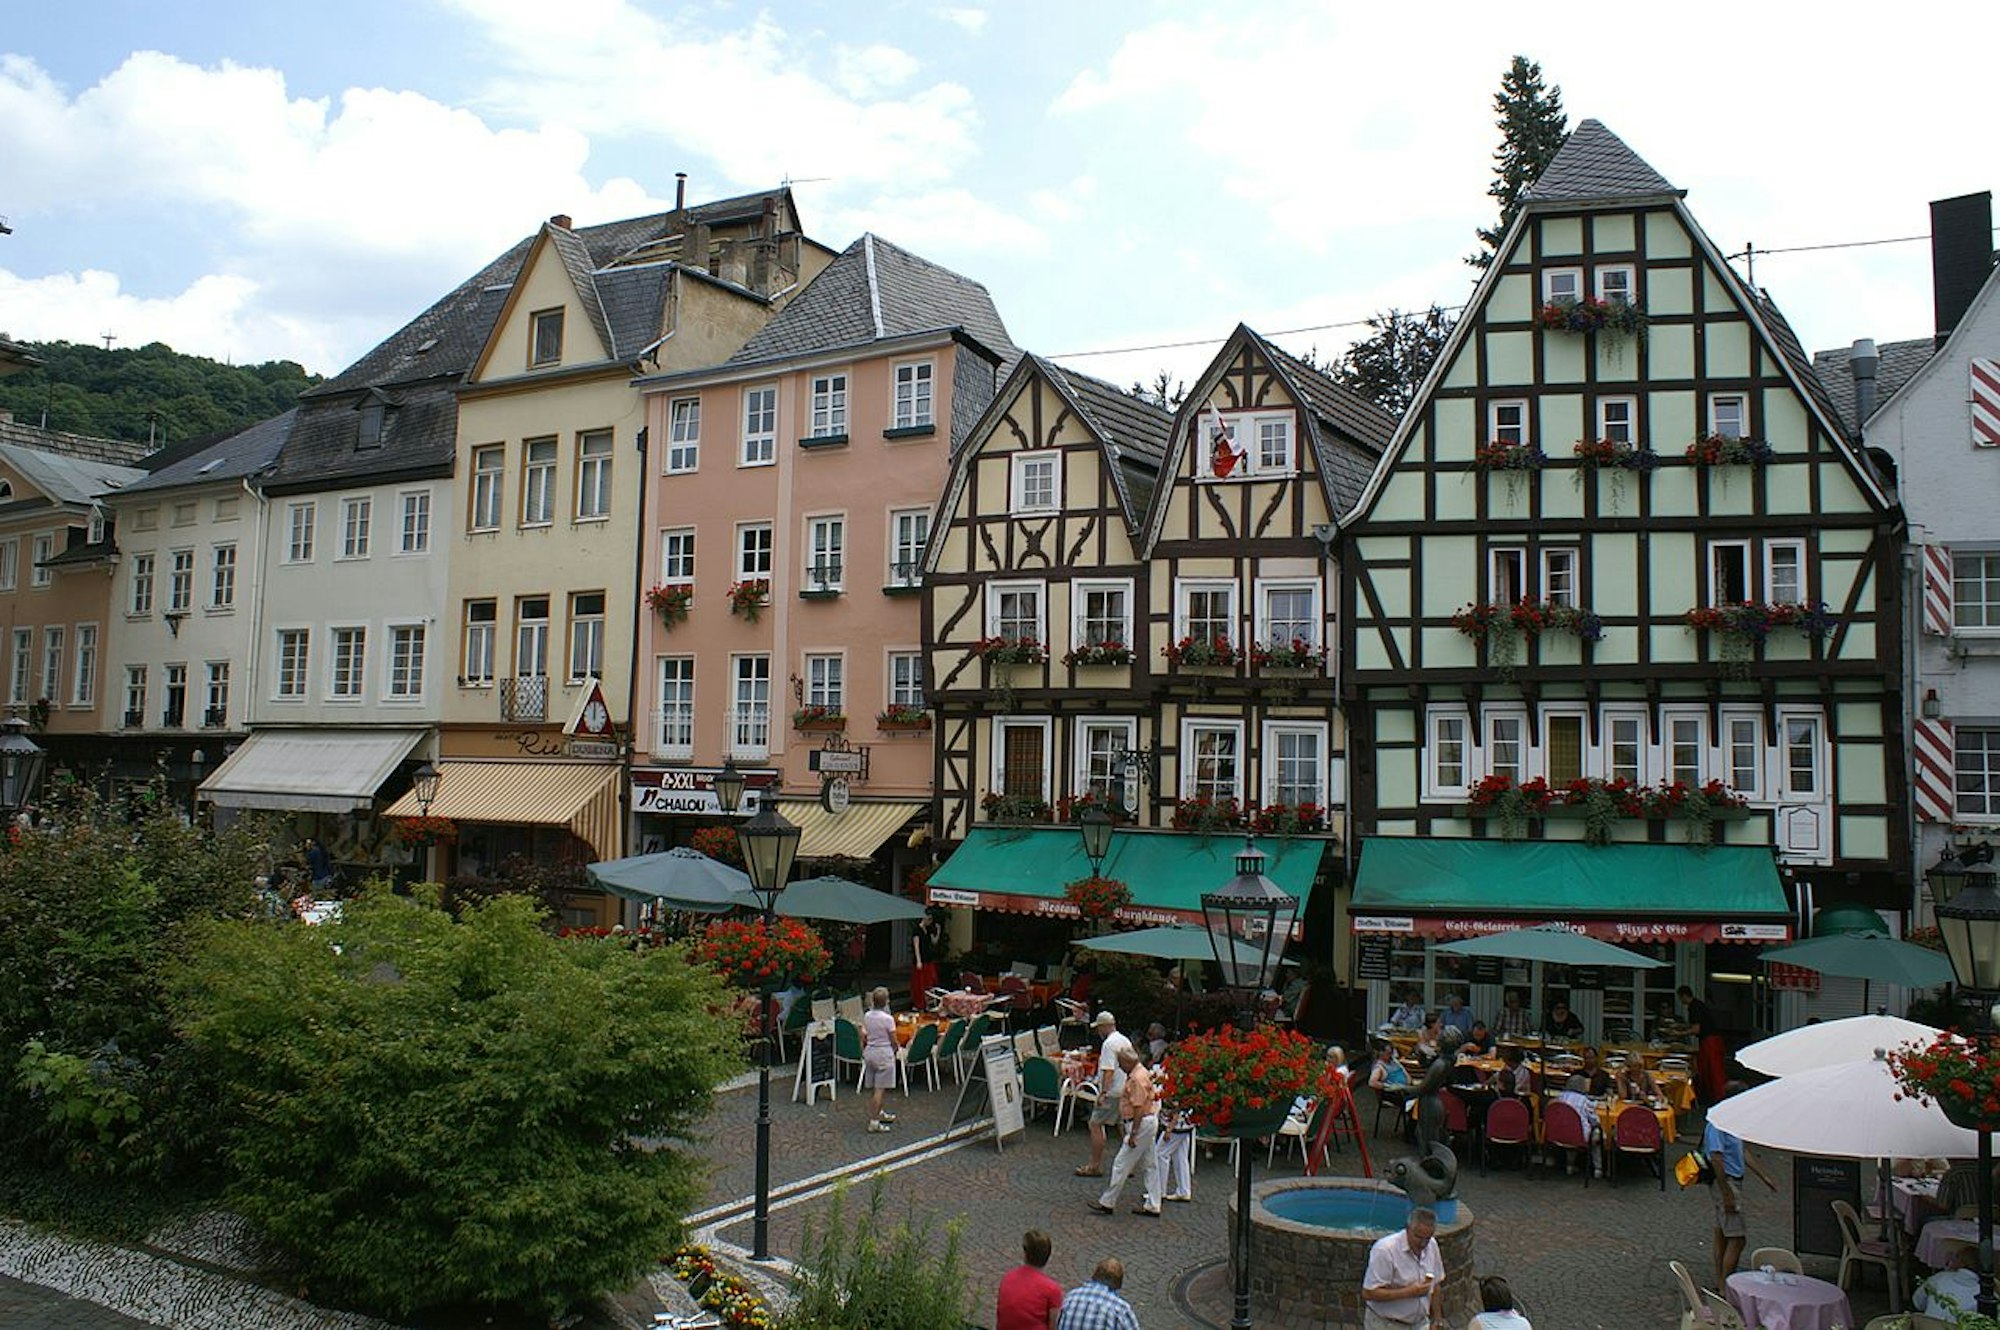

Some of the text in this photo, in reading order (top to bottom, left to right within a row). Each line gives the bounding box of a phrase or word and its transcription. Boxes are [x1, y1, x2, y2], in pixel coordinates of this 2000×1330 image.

[655, 797, 705, 811] CHALOU
[1038, 900, 1081, 915] Restau
[1616, 922, 1648, 937] Pizza
[1651, 923, 1664, 935] &
